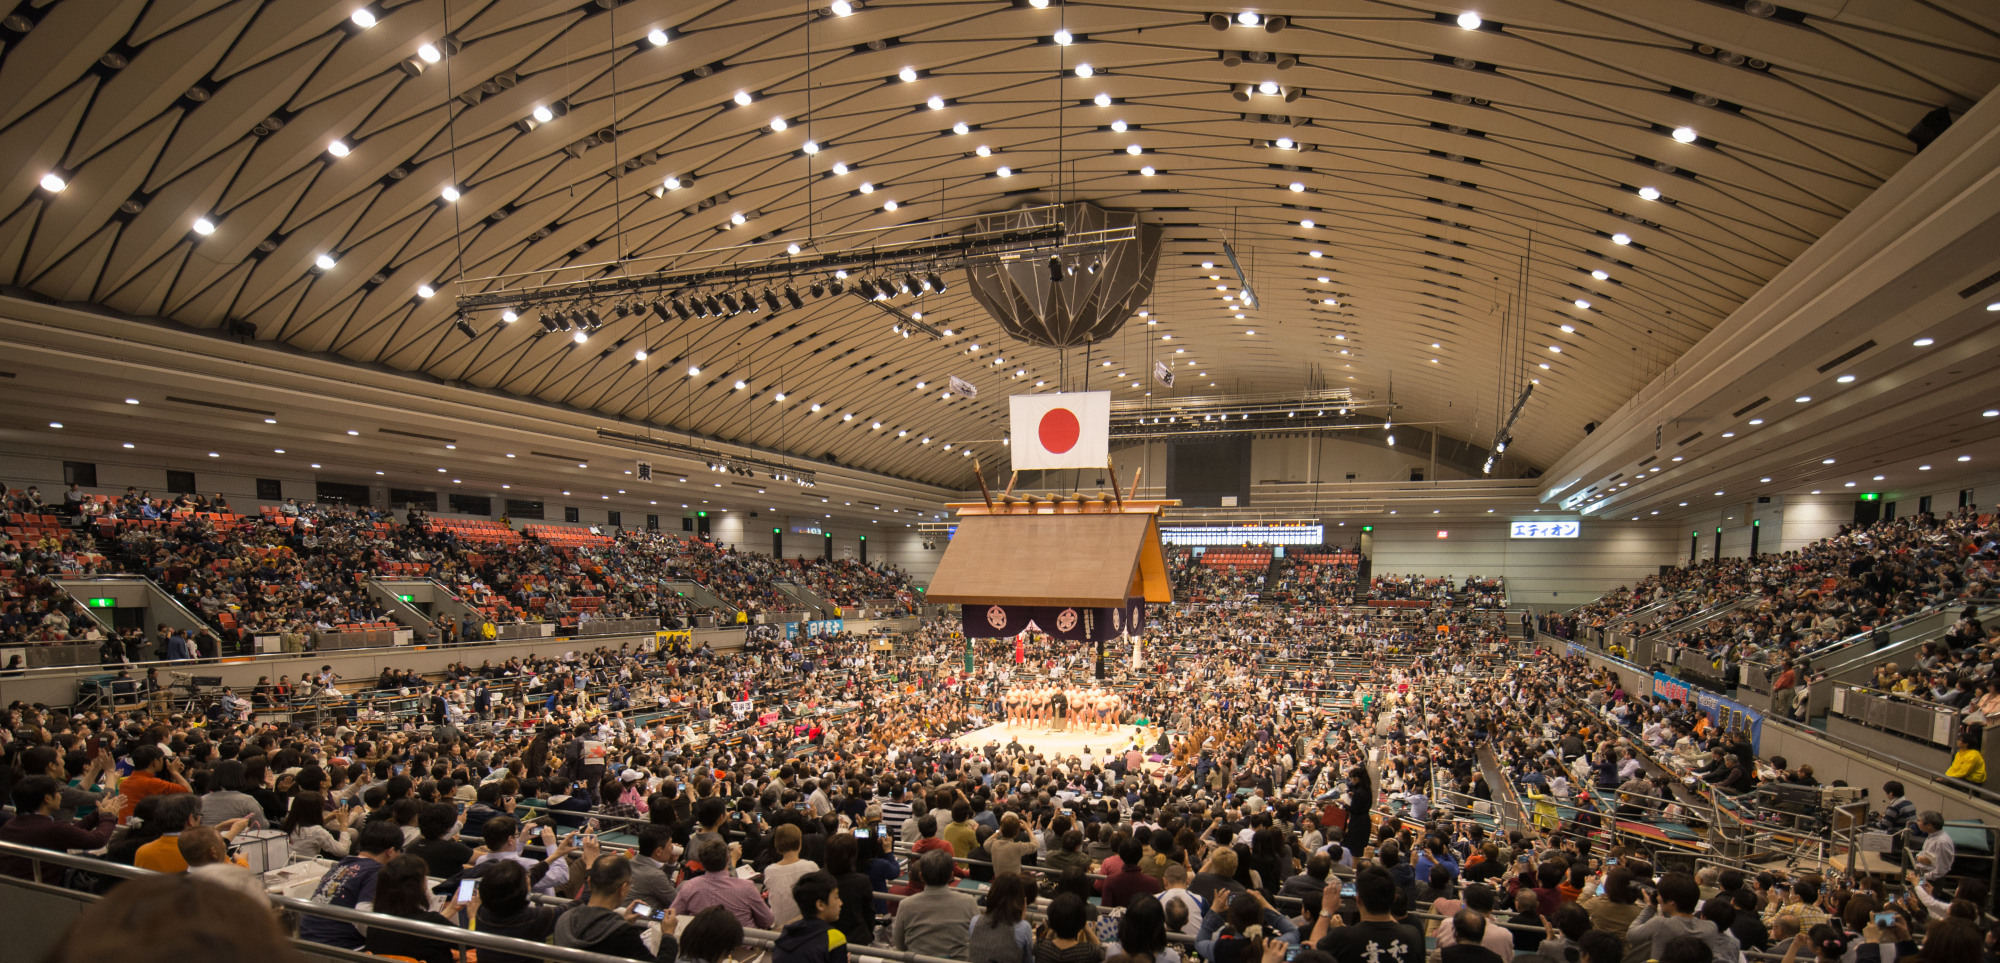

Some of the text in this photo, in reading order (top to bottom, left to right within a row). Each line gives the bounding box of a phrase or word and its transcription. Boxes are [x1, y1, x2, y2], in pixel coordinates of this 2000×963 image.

[638, 463, 651, 480] 東
[1514, 524, 1576, 537] エティオン
